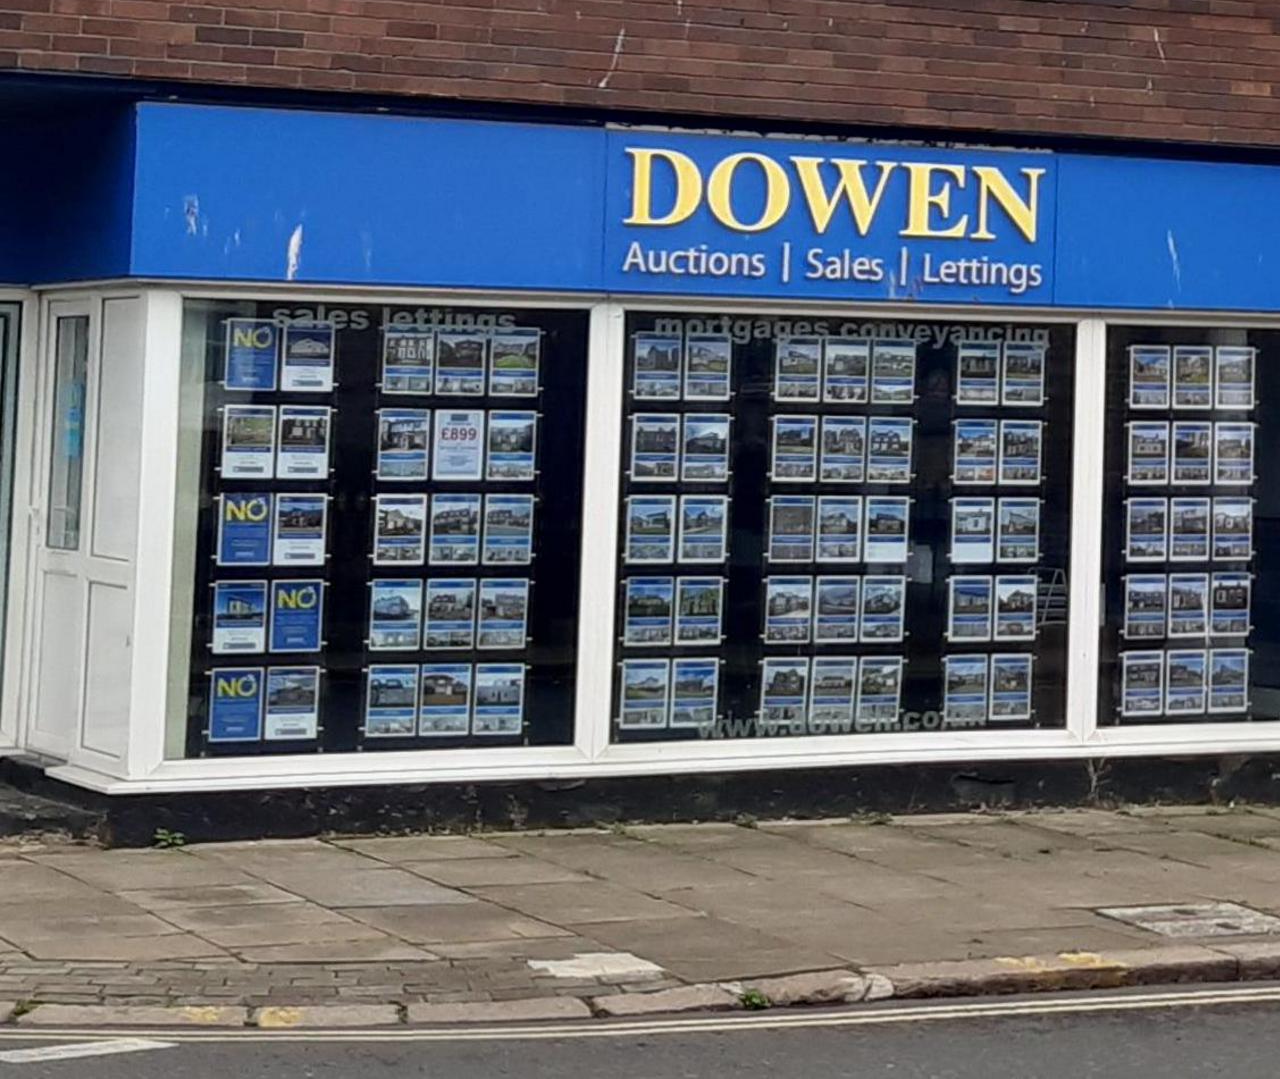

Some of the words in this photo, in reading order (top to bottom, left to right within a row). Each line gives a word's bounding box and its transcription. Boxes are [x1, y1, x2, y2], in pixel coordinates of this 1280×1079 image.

[621, 146, 1047, 243] DOWEN
[621, 241, 766, 278] Auctions
[805, 246, 884, 283] Sales
[923, 252, 1043, 295] Lettings
[272, 305, 371, 331] sales
[383, 307, 516, 338] lettings
[655, 316, 830, 344] mortgages
[840, 322, 1049, 350] conveyancing
[233, 327, 272, 349] NO
[440, 427, 478, 441] £899
[226, 497, 268, 521] NO
[278, 586, 317, 609] NO
[217, 675, 257, 698] NO
